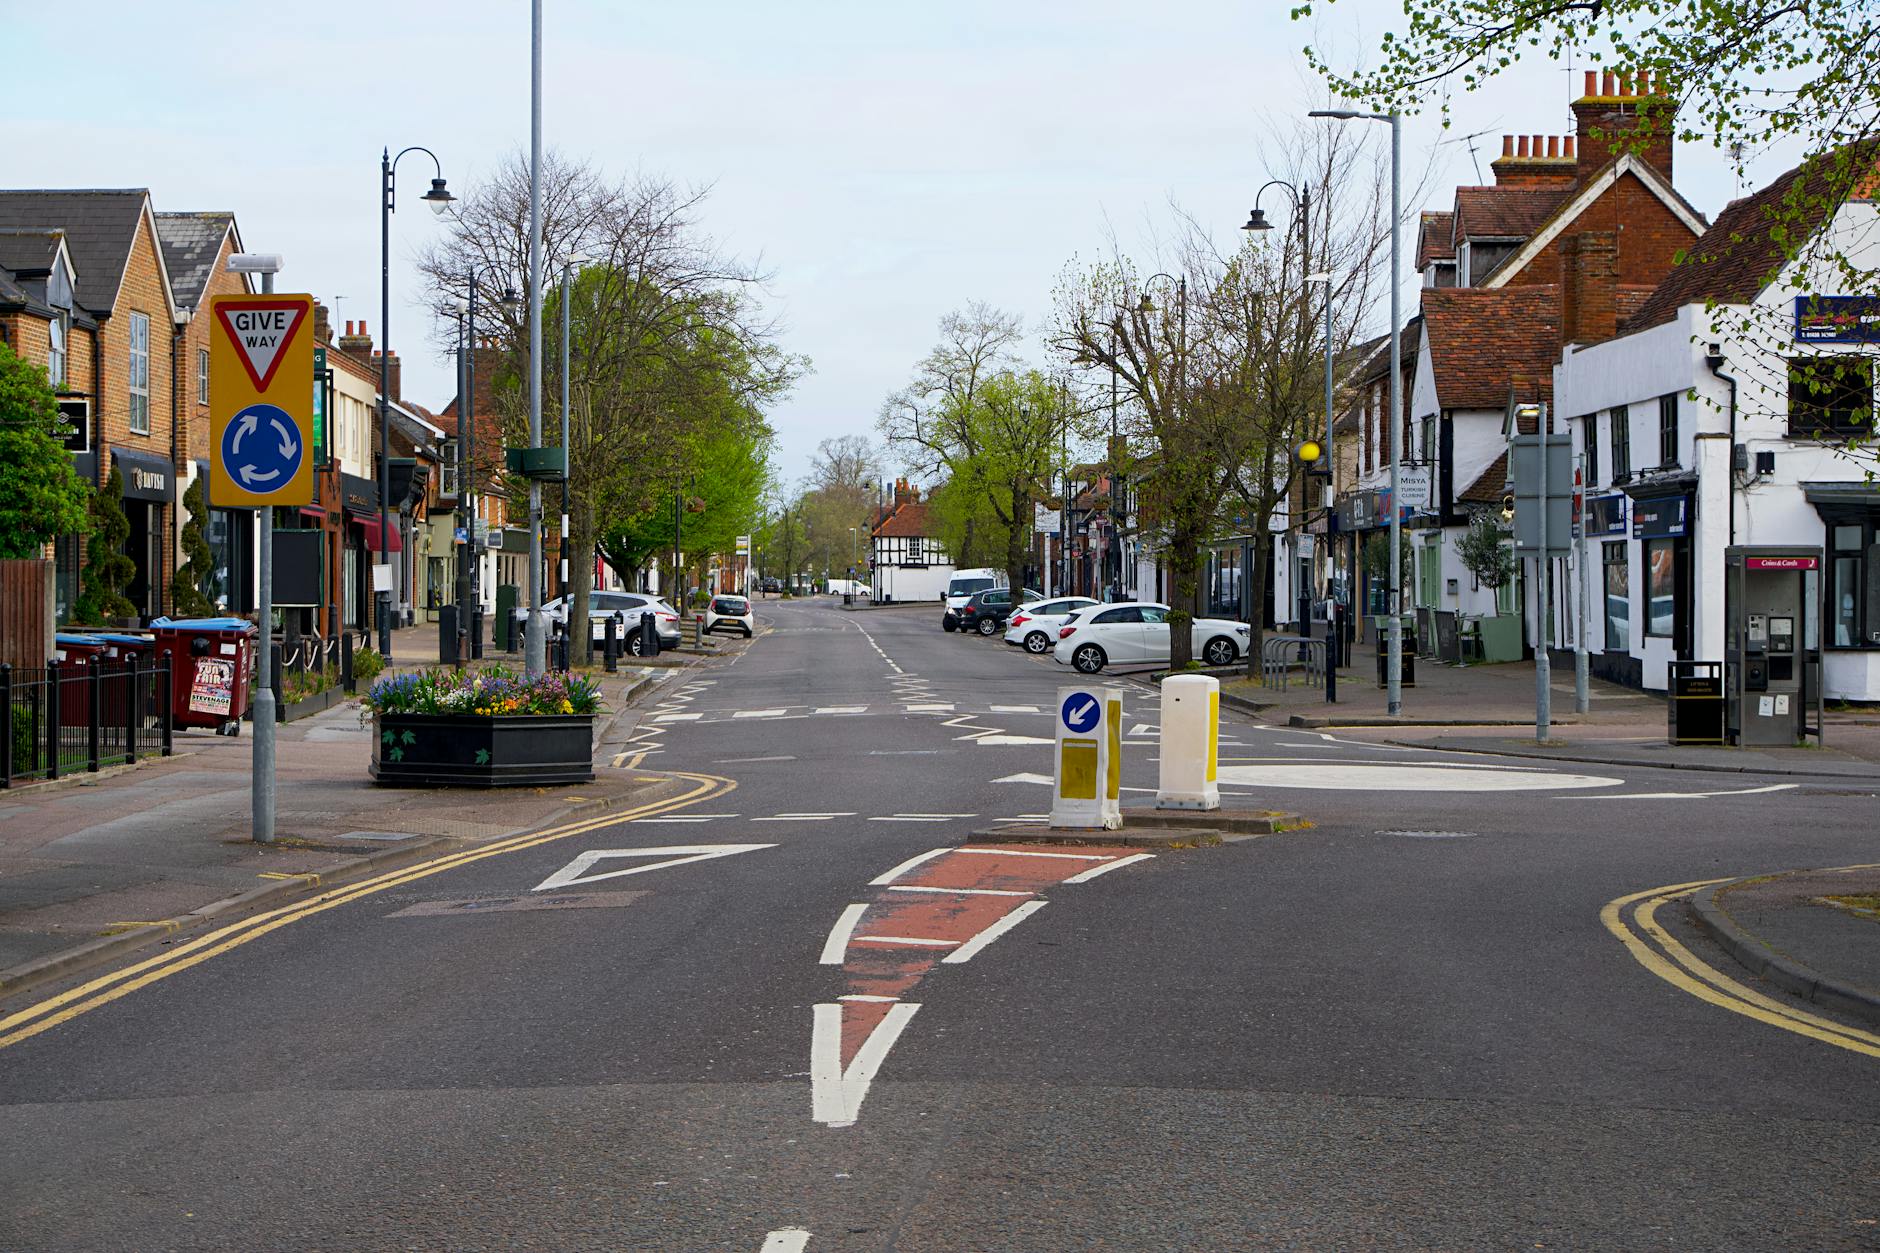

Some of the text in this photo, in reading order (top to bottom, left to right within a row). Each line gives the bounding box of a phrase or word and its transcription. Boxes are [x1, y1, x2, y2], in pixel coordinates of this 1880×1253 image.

[235, 312, 285, 331] GIVE
[246, 336, 277, 348] WAY
[192, 694, 229, 704] STEVENAGE
